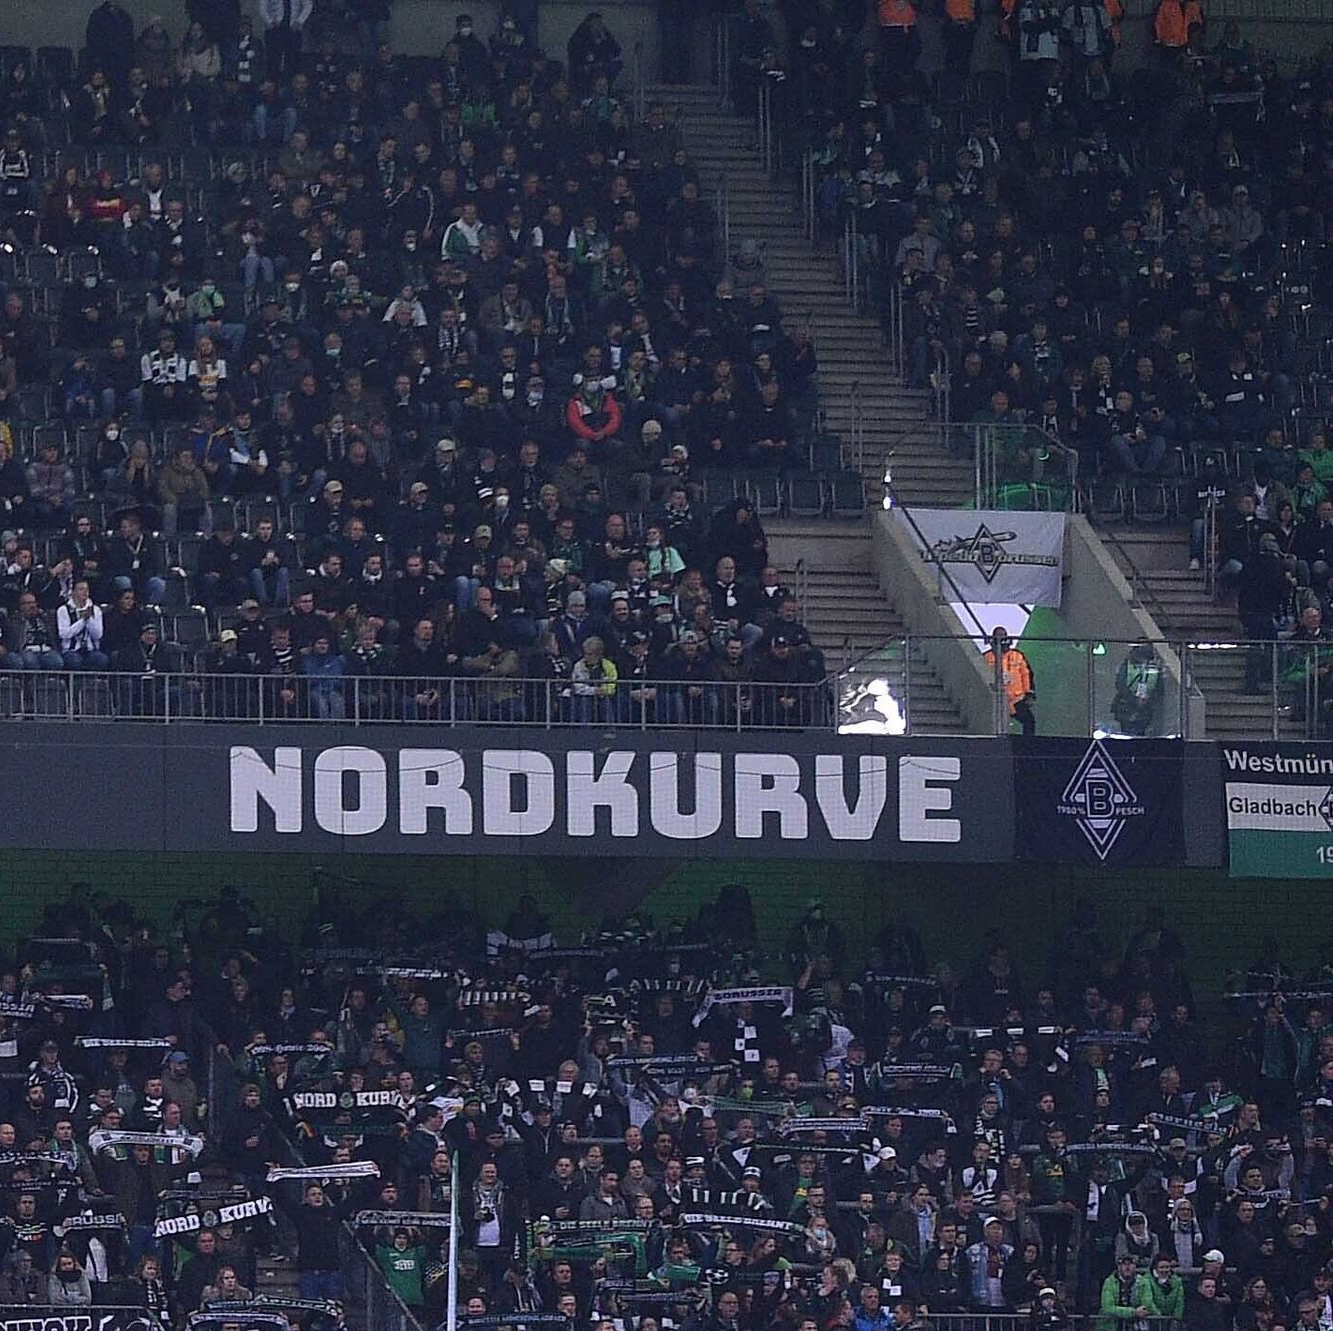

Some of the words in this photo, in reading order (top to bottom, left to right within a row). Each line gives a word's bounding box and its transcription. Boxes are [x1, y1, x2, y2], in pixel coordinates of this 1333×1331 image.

[229, 746, 961, 843] NORDKURVE
[1116, 806, 1145, 815] PESCH
[1229, 797, 1317, 817] Gladbach
[714, 988, 782, 999] BORUSSIA
[295, 1092, 337, 1109] NORD
[155, 1214, 201, 1237] NORD
